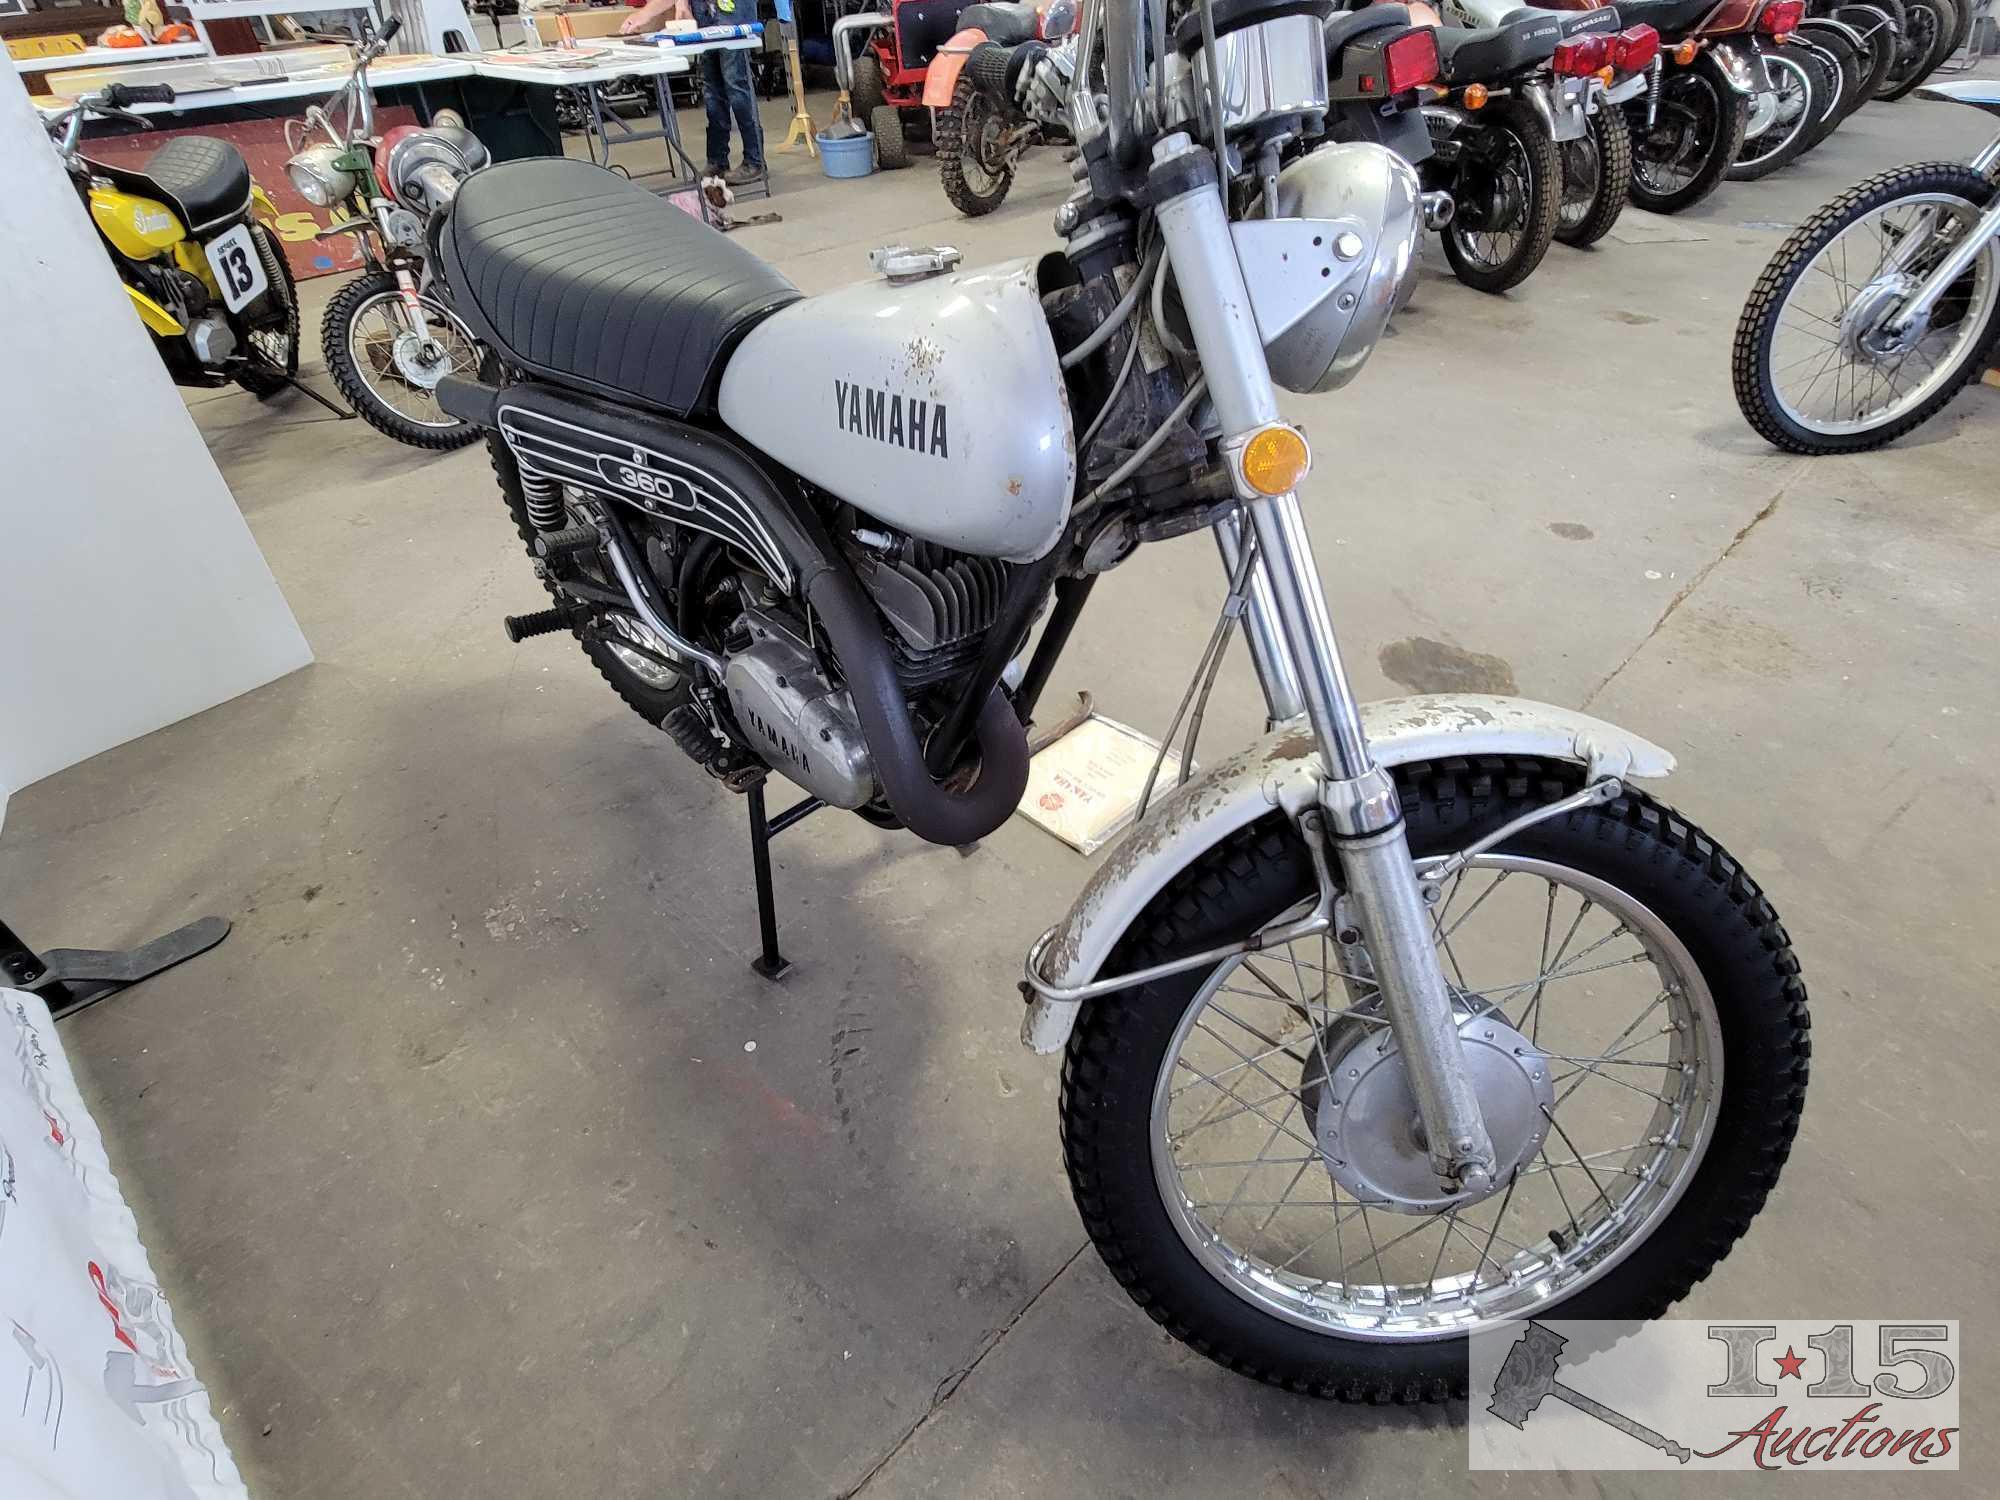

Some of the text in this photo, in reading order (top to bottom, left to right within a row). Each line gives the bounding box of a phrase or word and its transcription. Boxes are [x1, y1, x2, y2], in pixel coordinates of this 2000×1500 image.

[1571, 15, 1611, 32] KAWASAKI
[219, 247, 253, 301] 13
[834, 379, 949, 459] YAMAHA
[619, 466, 674, 499] 360
[747, 707, 812, 775] YAMAHA
